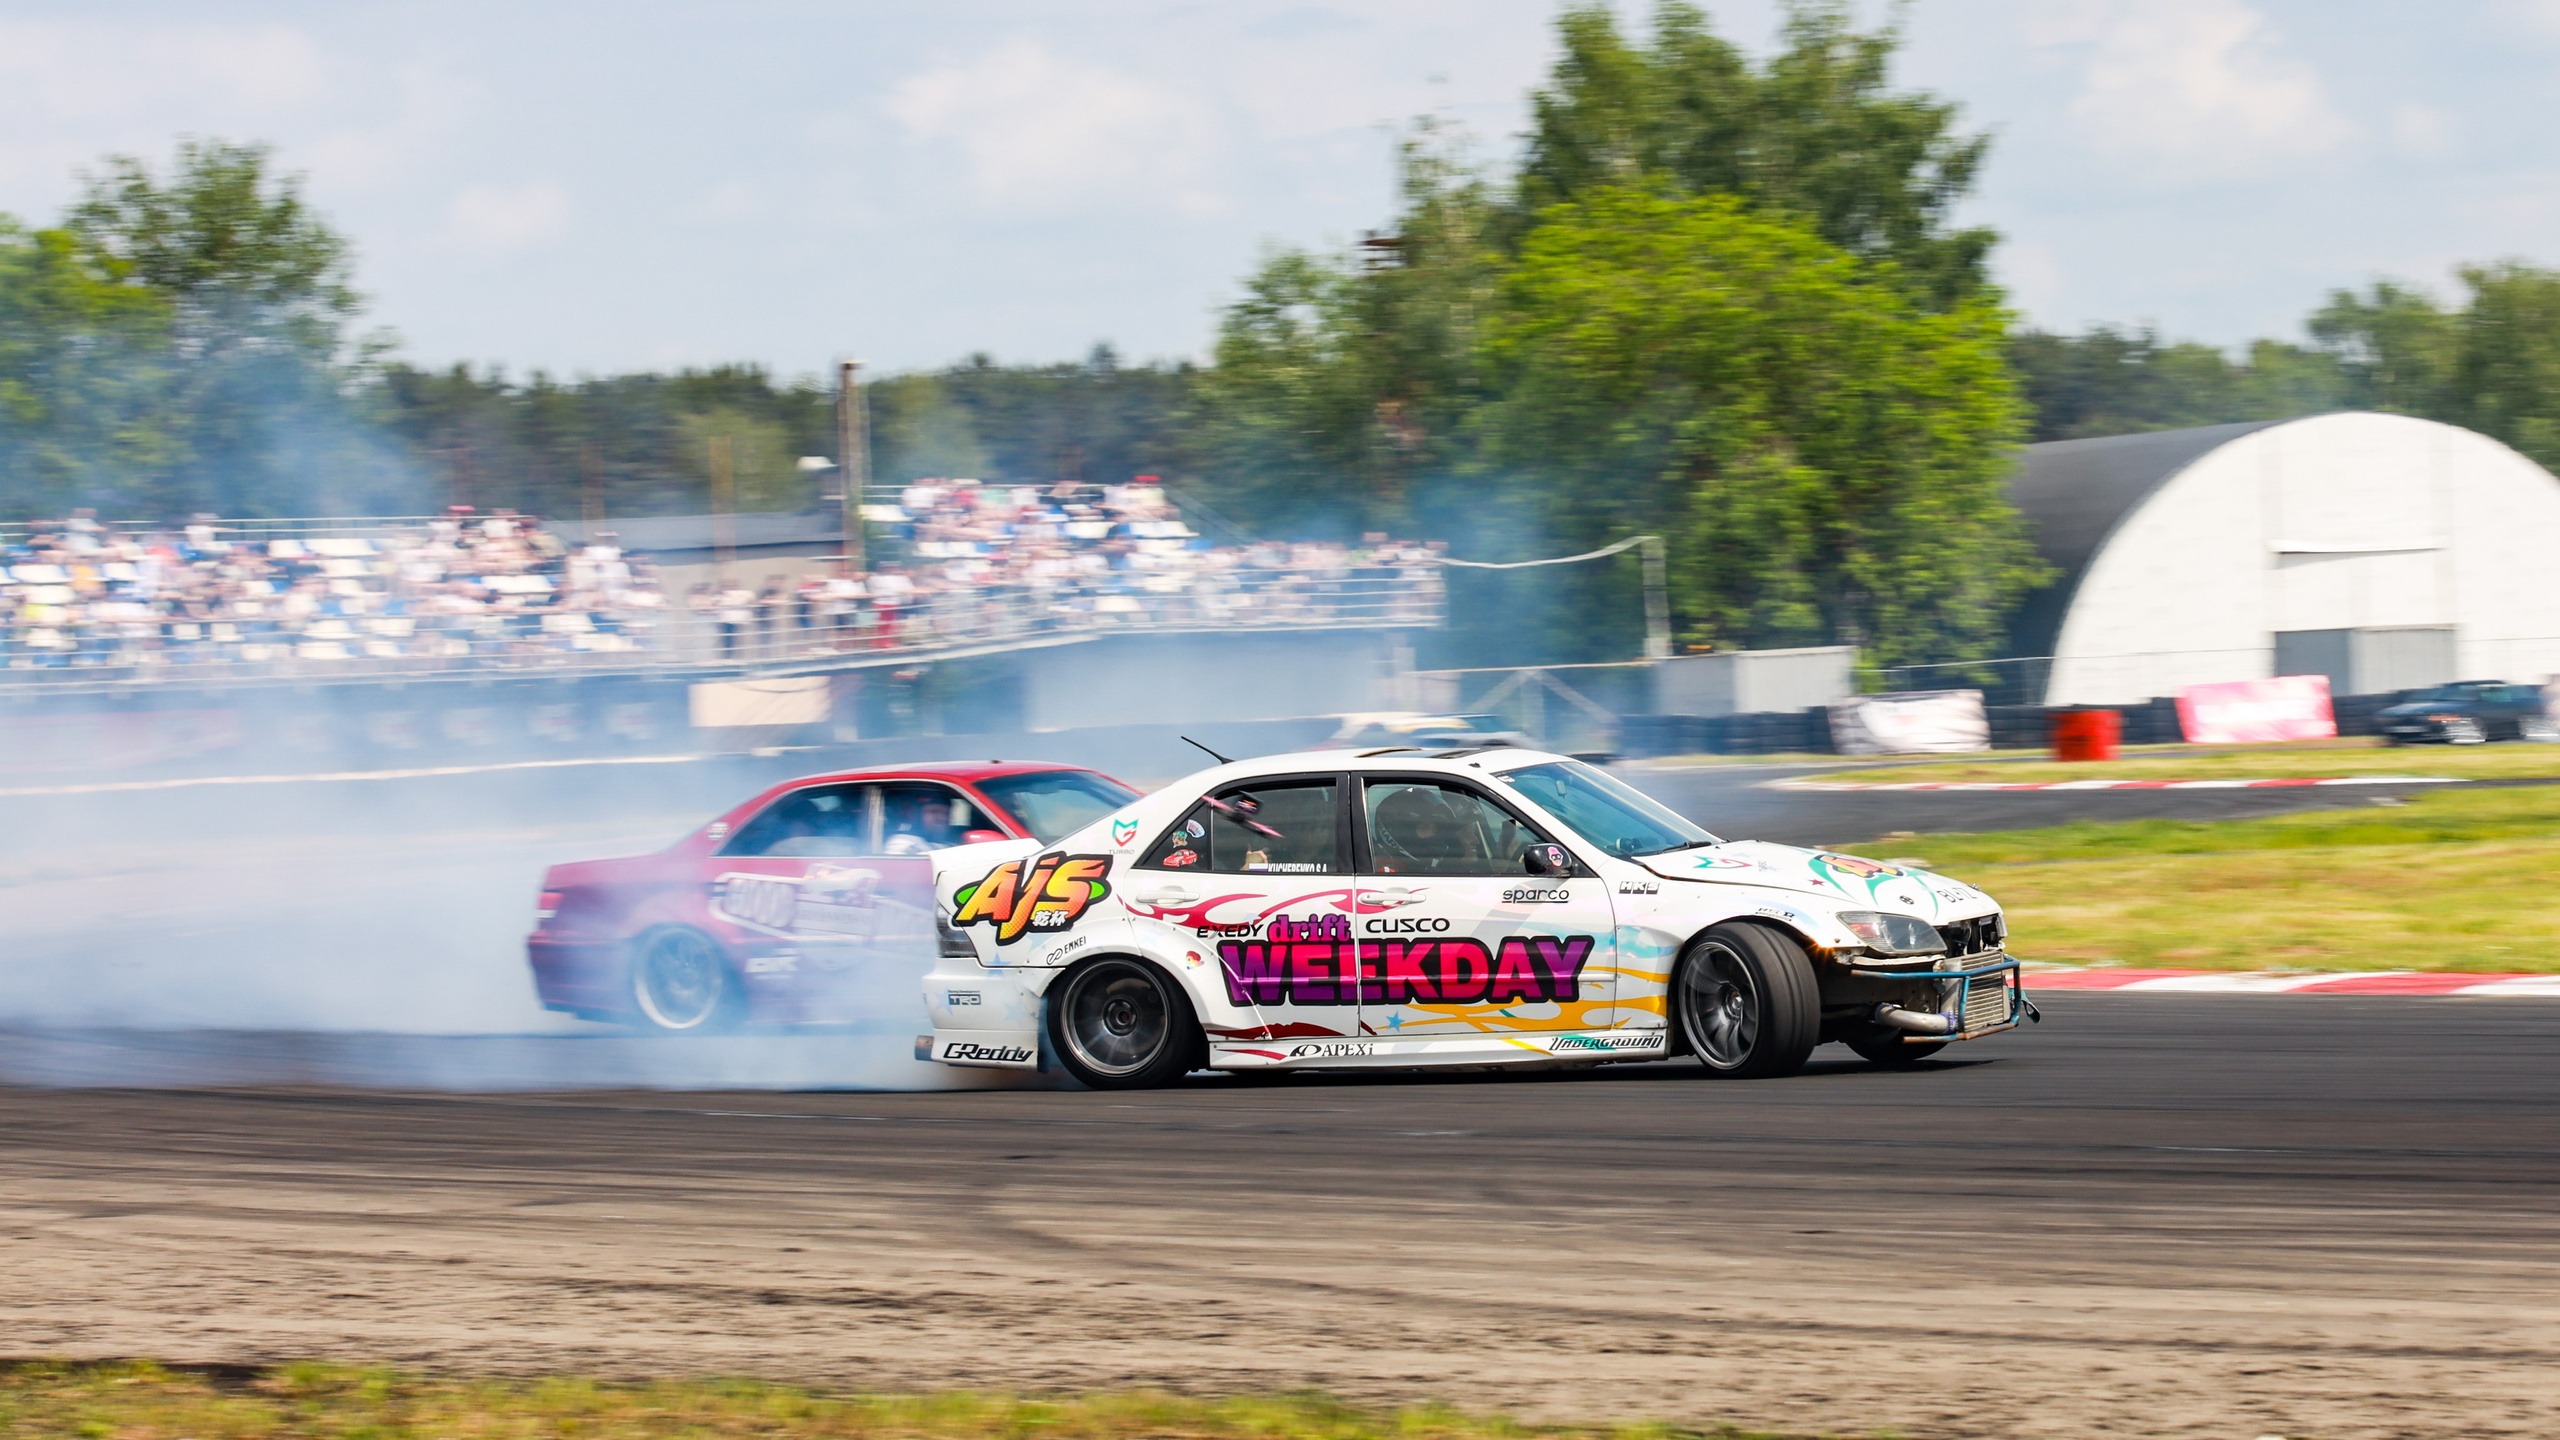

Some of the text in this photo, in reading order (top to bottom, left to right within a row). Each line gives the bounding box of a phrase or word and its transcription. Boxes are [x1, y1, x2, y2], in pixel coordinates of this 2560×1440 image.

[1503, 889, 1569, 904] sparco
[1619, 881, 1660, 895] HKS
[1032, 909, 1069, 927] 乾杯
[1365, 917, 1450, 933] CUSCO
[1196, 924, 1264, 939] EXEDY
[1267, 914, 1351, 943] drift
[1064, 936, 1087, 954] ENKEI
[1218, 937, 1593, 1005] WEEKDAY
[1549, 1035, 1664, 1051] UNDERGROUND
[943, 1043, 1034, 1063] GReddy
